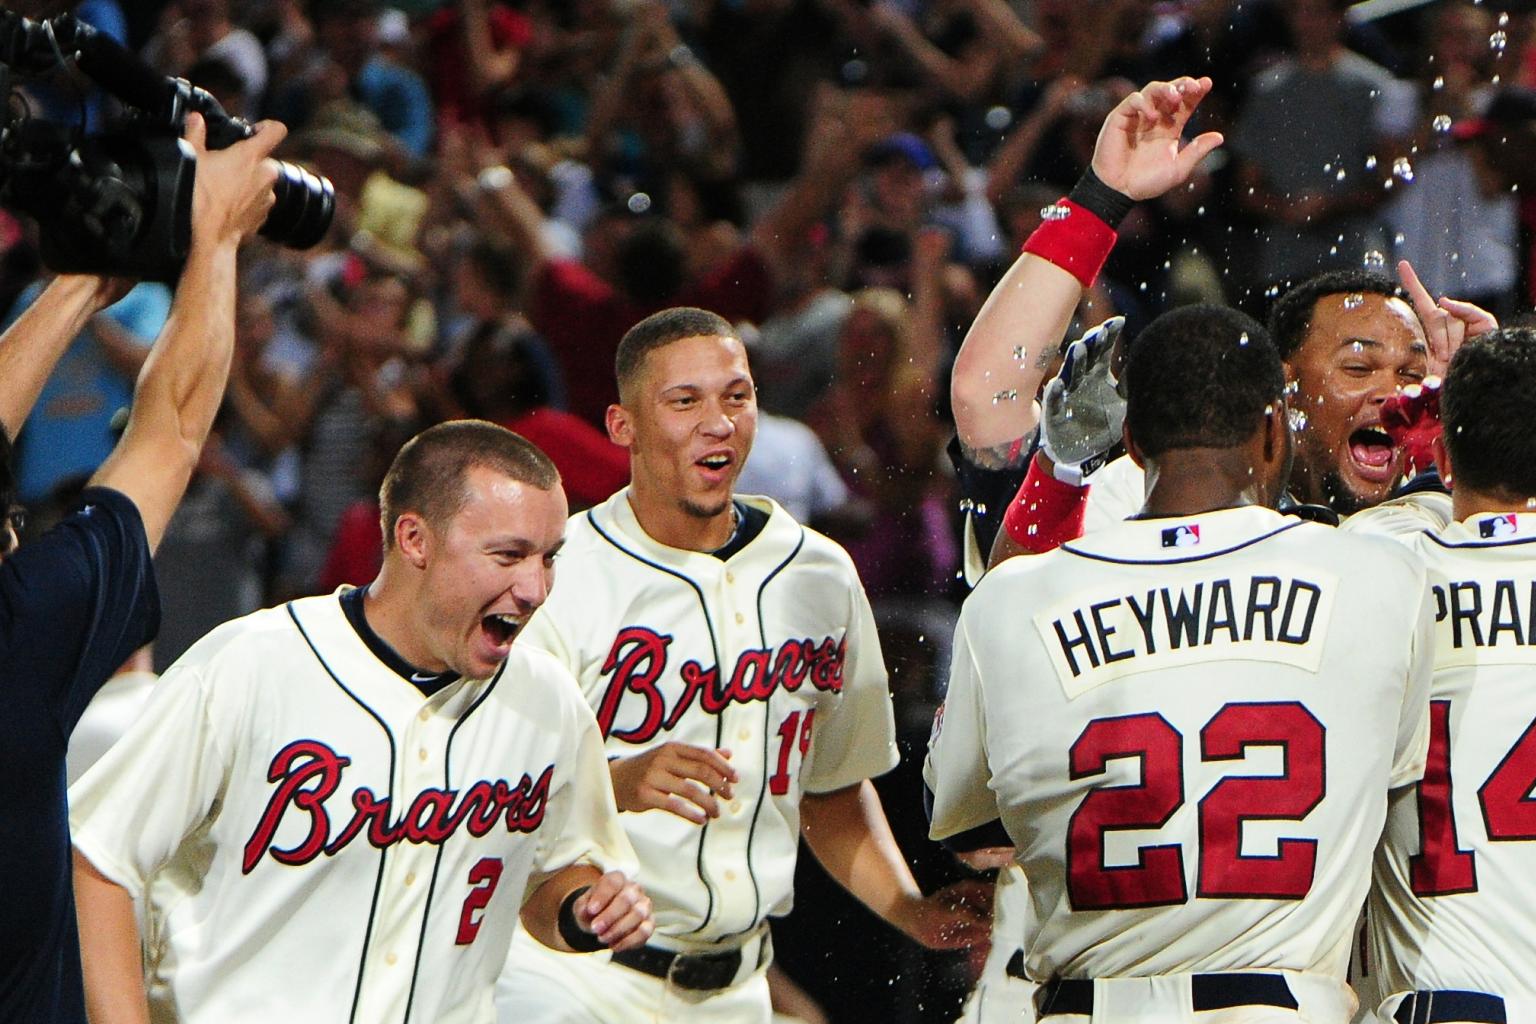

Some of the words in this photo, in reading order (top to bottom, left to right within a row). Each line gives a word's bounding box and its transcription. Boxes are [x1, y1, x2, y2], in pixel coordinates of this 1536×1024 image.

[596, 625, 848, 744] Braves
[1052, 576, 1322, 677] HEYWARD
[242, 739, 555, 876] Braves
[1067, 700, 1327, 911] 22
[455, 857, 504, 945] 2
